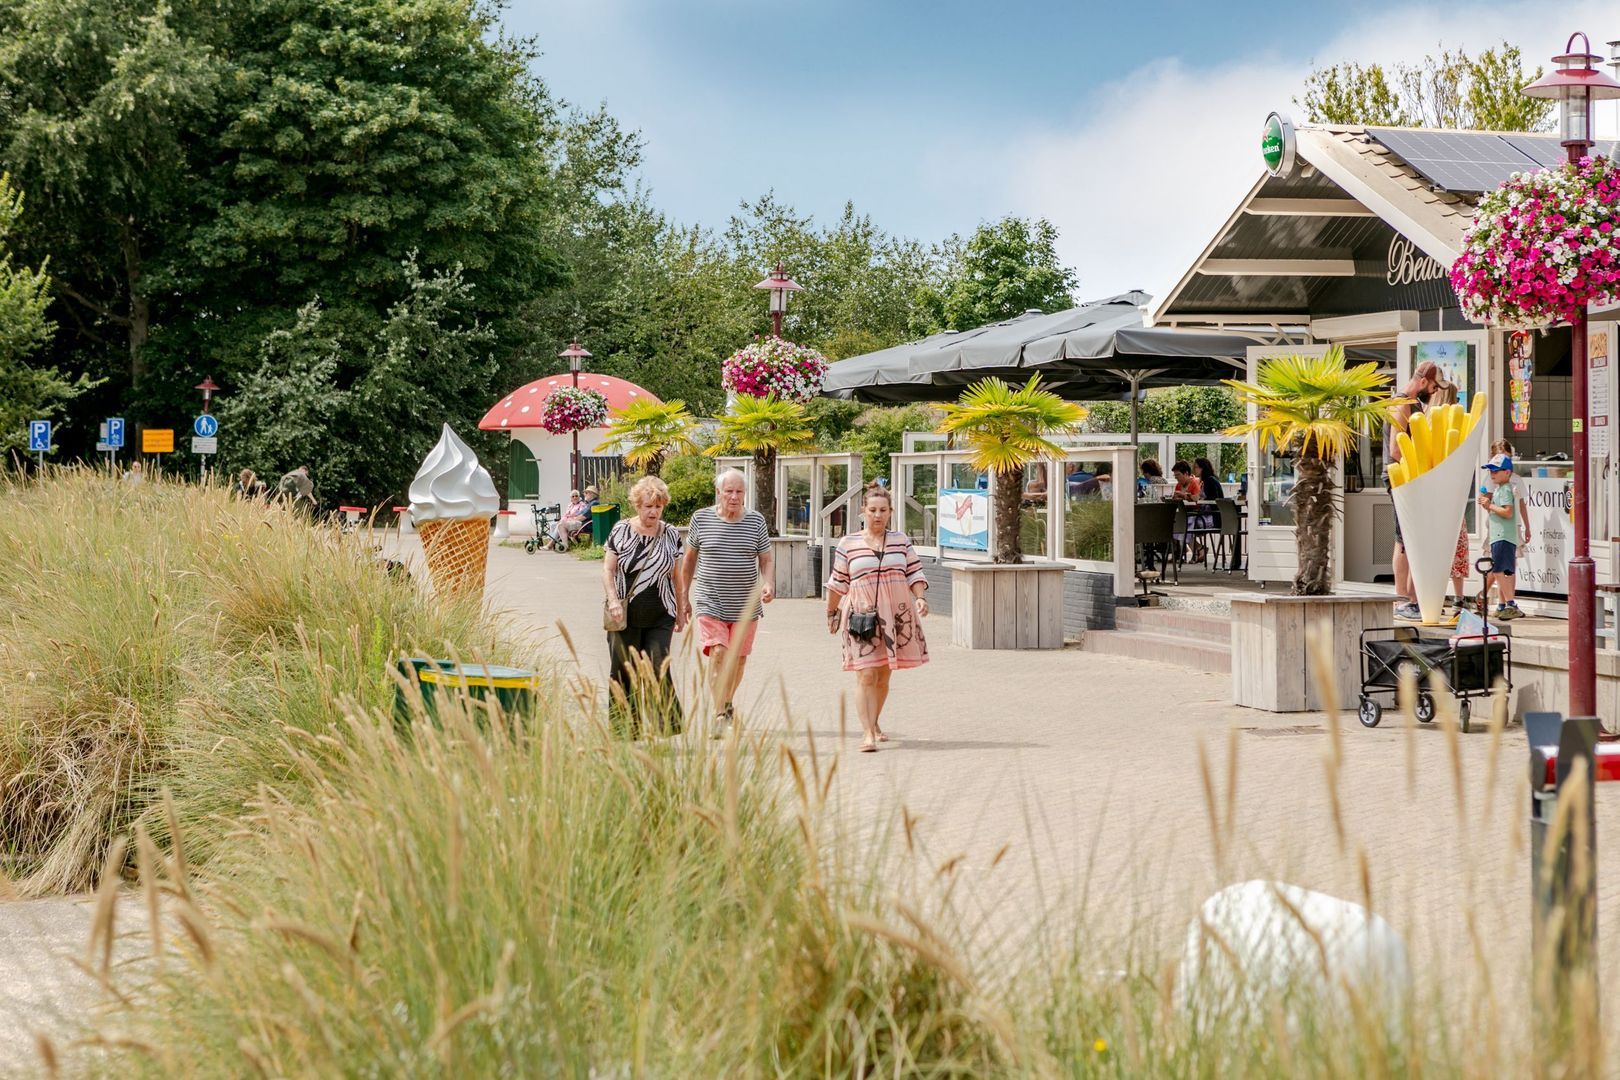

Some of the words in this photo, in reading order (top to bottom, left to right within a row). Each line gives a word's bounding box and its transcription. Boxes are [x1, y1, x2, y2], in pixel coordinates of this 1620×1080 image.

[34, 423, 46, 438] P
[111, 421, 120, 434] P
[1525, 485, 1573, 509] kcorne
[1518, 568, 1536, 582] Vers
[1537, 567, 1561, 588] Softijs
